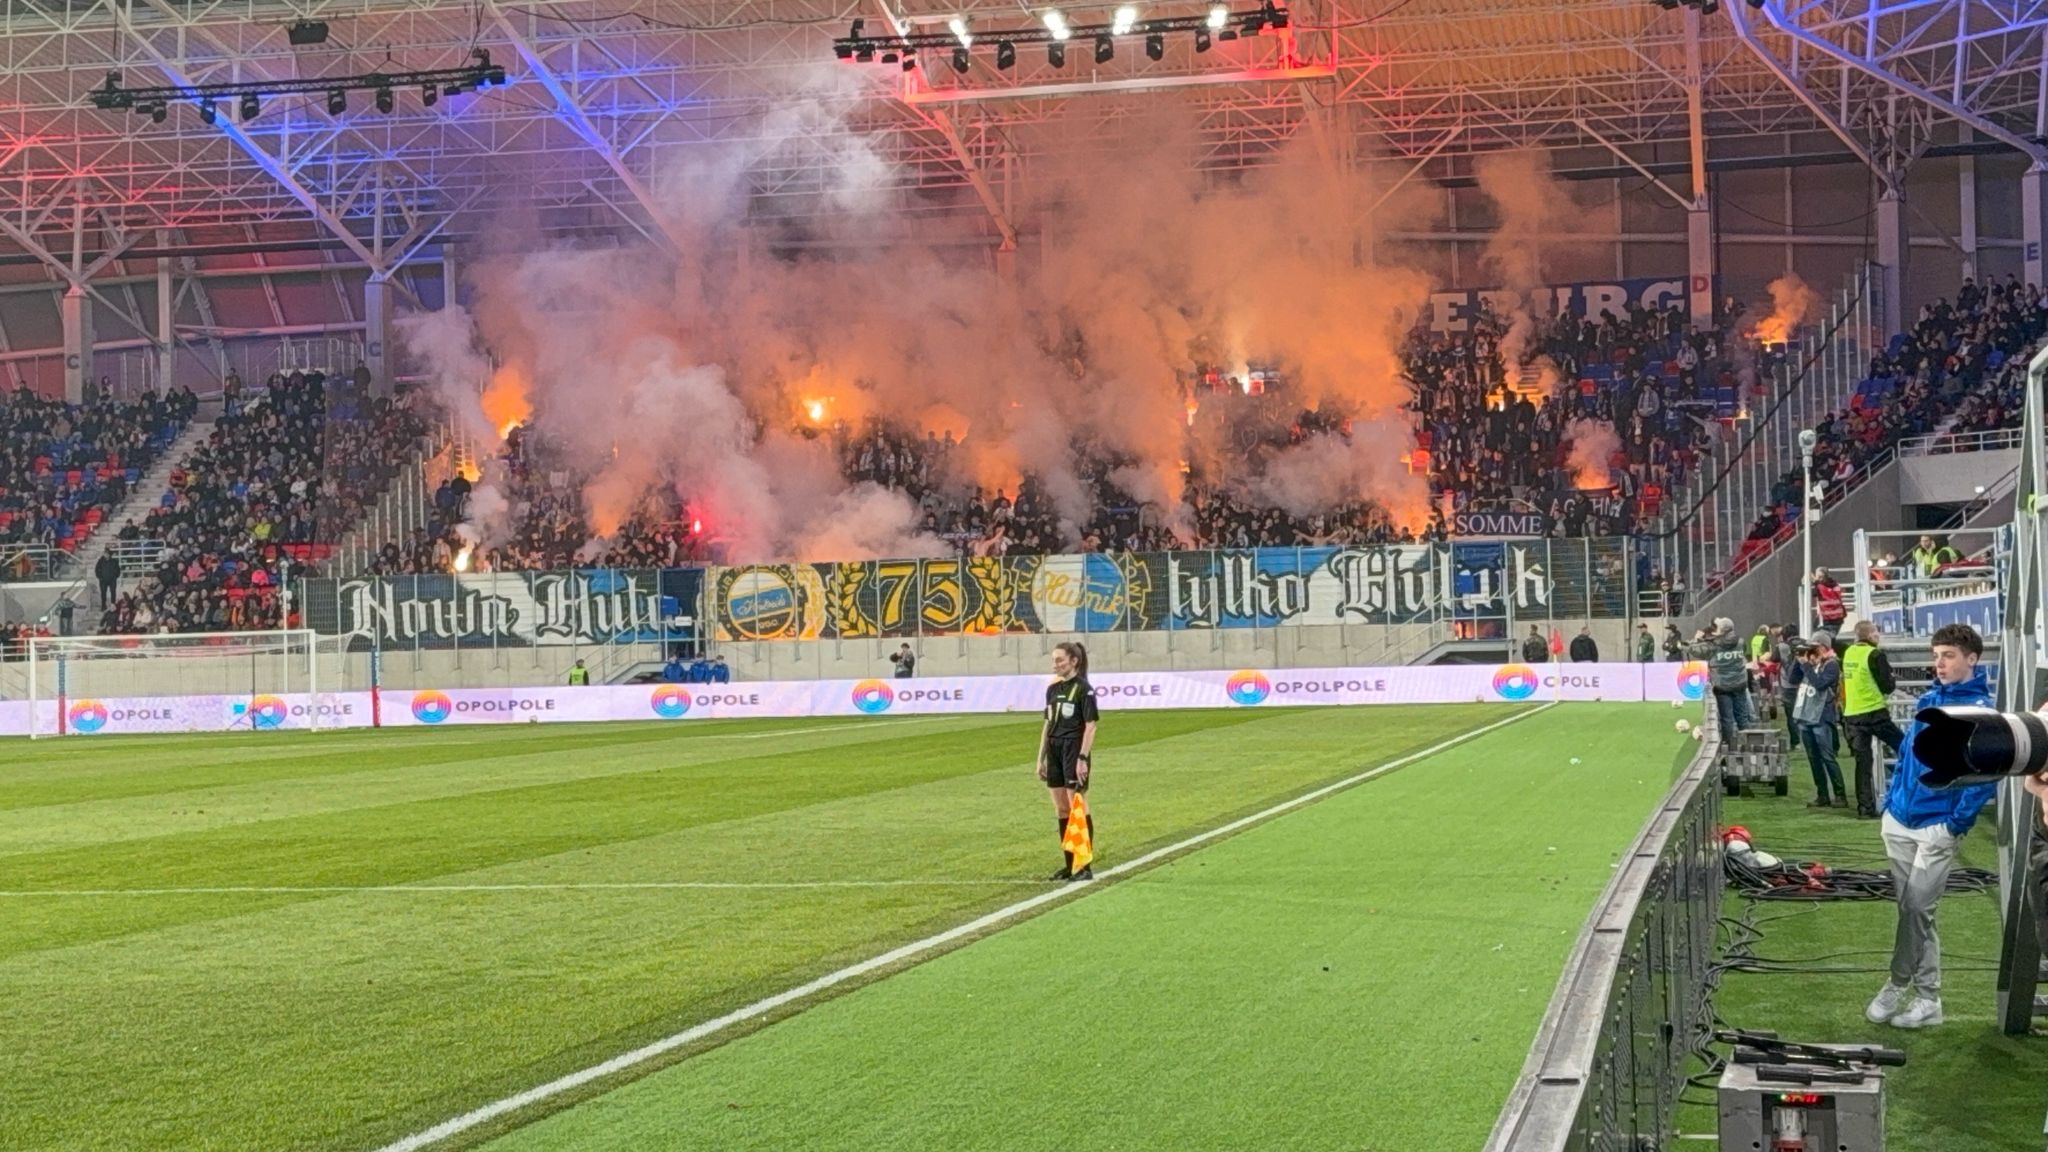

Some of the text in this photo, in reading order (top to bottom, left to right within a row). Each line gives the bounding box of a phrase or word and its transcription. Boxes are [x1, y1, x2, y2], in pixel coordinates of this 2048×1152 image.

[2027, 242, 2039, 261] E
[1692, 275, 1709, 293] D
[368, 343, 382, 357] C
[66, 354, 80, 370] C
[1456, 514, 1543, 535] SOMME
[873, 561, 966, 629] 75
[1166, 554, 1306, 627] tylko
[330, 580, 519, 642] Nowa
[1094, 684, 1162, 698] OPOLE
[1275, 680, 1386, 694] OPOLPOLE
[696, 694, 760, 707] OPOLE
[898, 689, 964, 702] OPOLE
[456, 699, 555, 712] OPOLPOLE
[112, 709, 172, 720] OPOLE
